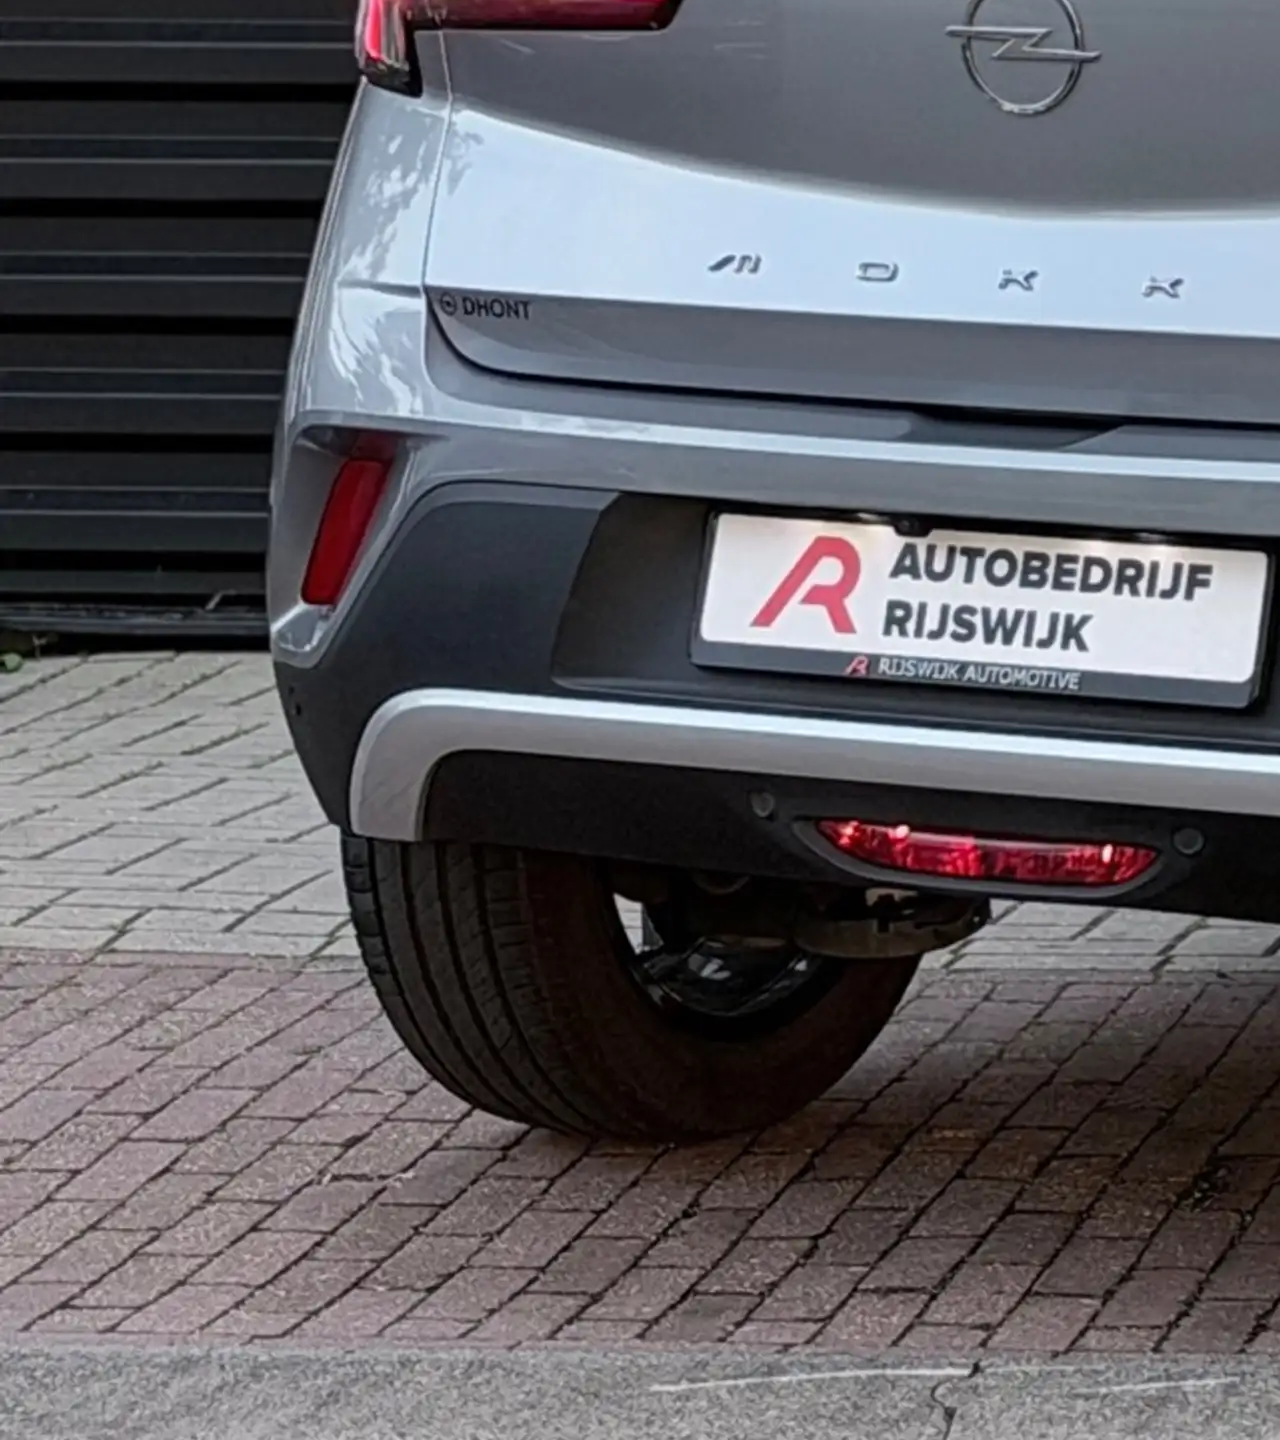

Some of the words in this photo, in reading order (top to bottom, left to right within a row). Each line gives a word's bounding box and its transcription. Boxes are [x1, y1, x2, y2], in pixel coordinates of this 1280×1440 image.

[461, 297, 531, 321] DHONT
[888, 542, 1215, 602] AUTOBEDRIJF
[881, 599, 1095, 654] RIJSWIJK
[877, 657, 959, 681] RIJSWIJK
[963, 665, 1082, 691] AUTOMOTIVE
